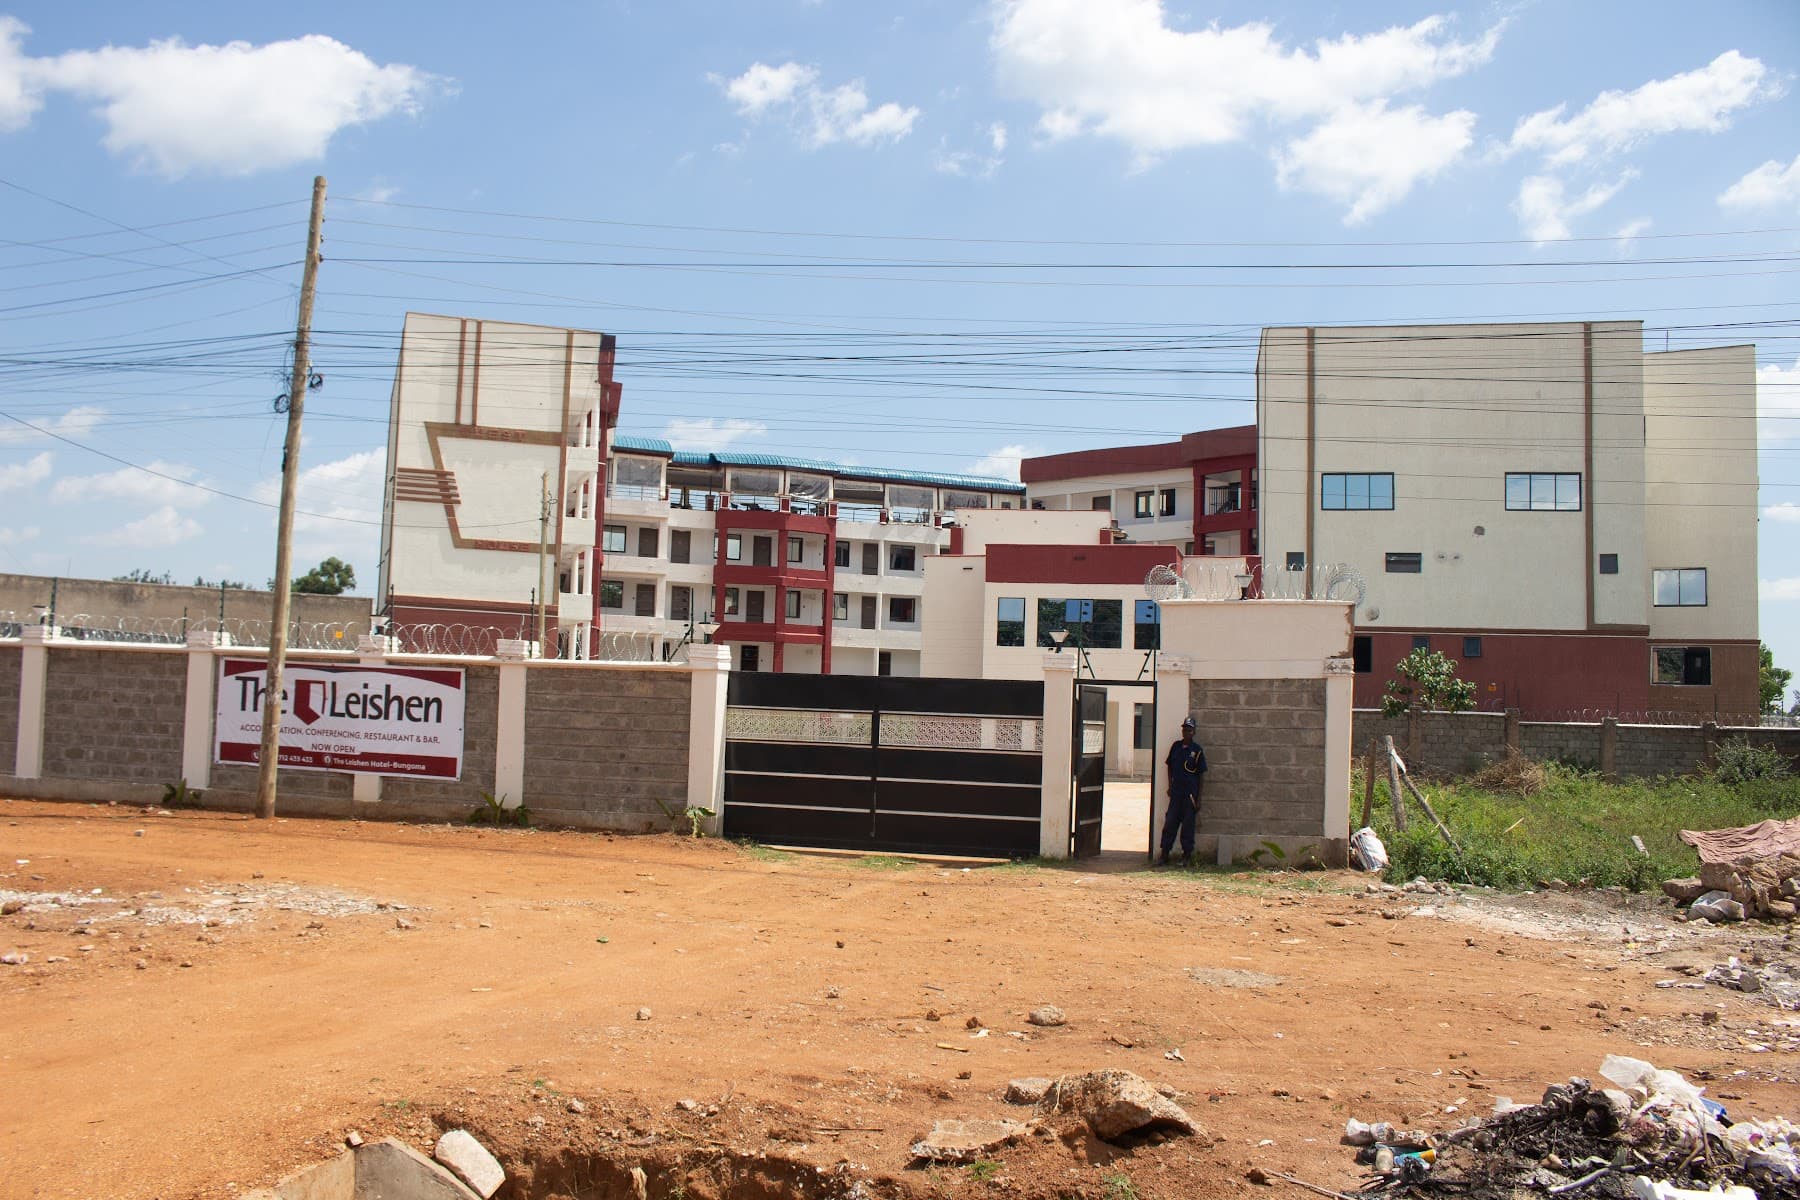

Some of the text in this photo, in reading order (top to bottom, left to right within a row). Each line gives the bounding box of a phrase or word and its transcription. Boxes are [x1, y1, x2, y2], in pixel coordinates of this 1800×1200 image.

[330, 681, 442, 723] Leishen
[364, 732, 415, 743] RESTAURANT
[415, 735, 421, 743] &
[311, 743, 355, 753] NOW OPEN
[345, 759, 369, 767] Leishen
